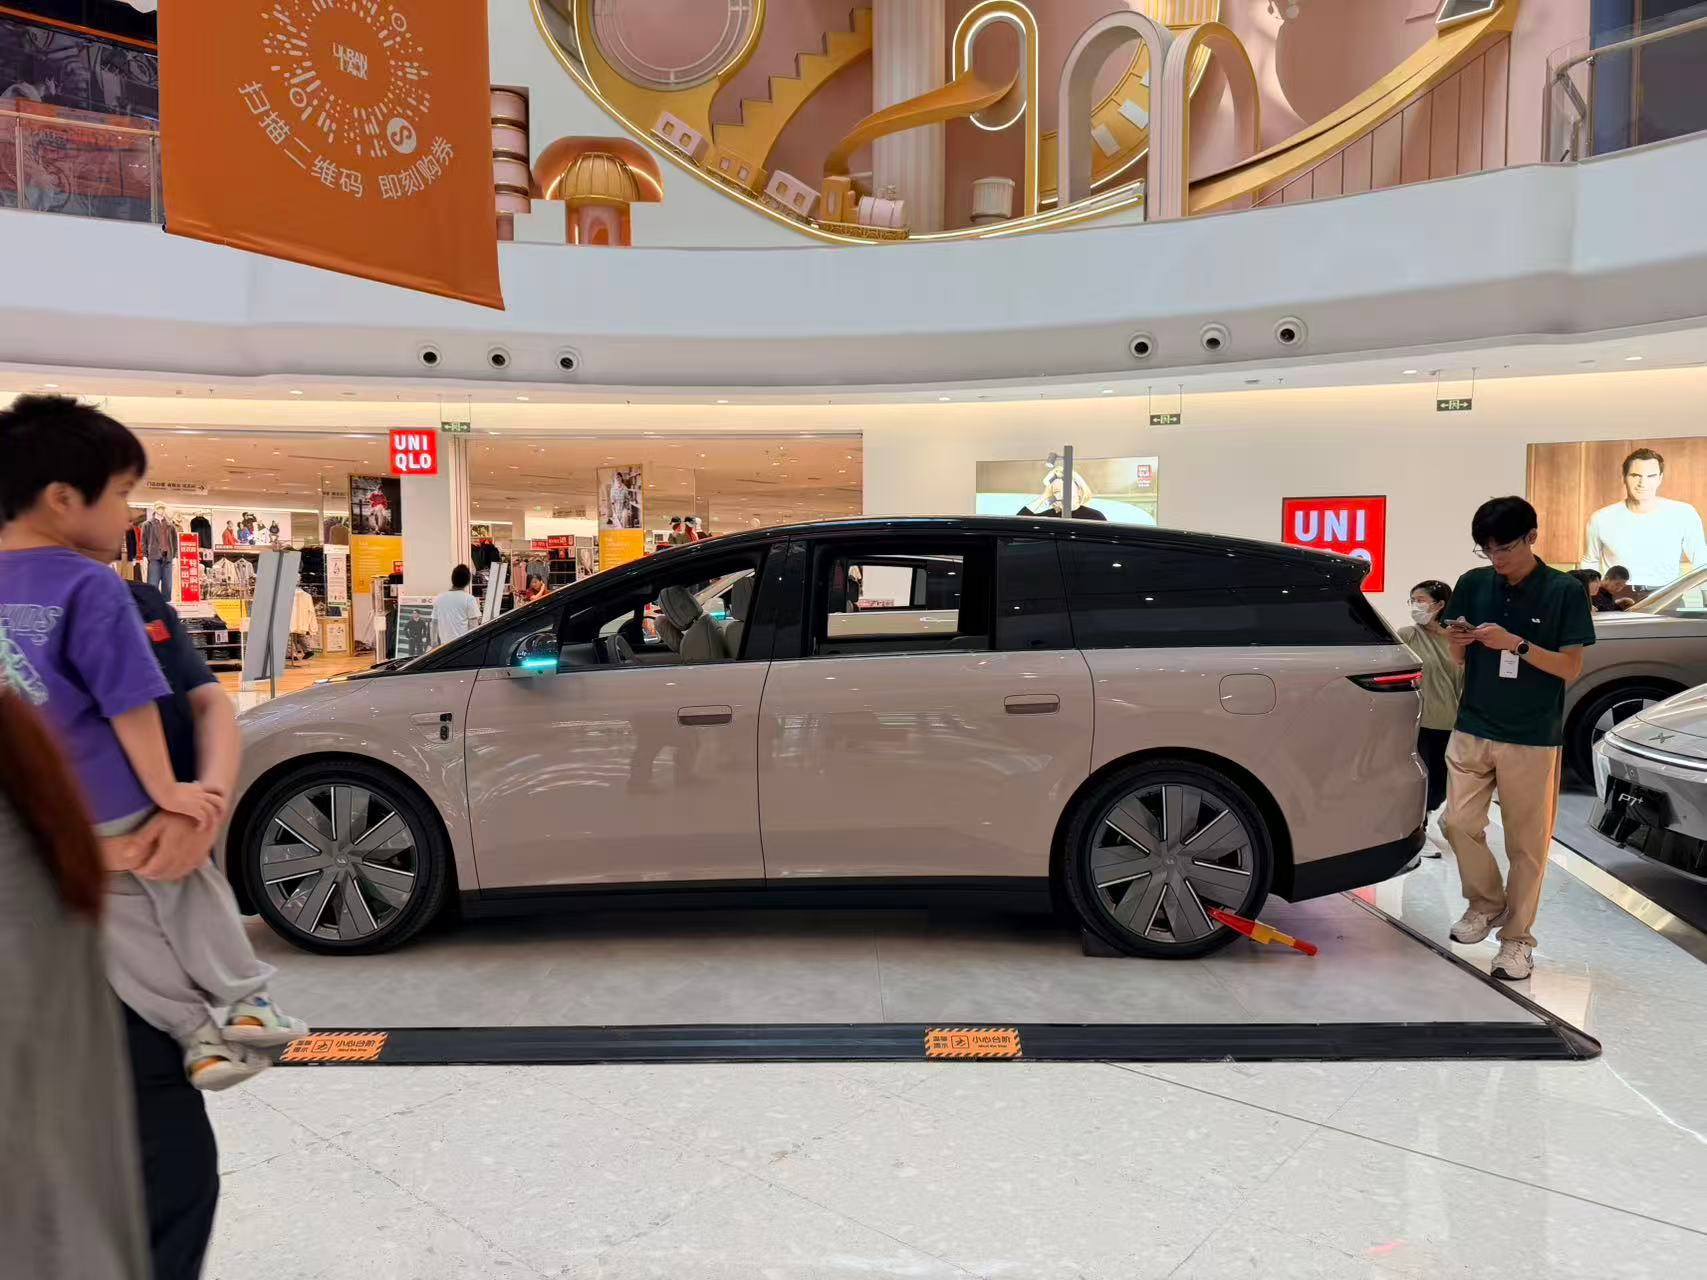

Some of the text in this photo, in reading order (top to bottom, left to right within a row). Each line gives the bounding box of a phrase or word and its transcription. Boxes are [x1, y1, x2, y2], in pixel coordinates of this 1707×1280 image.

[238, 80, 455, 199] 扫描二维码 即刻购券
[394, 434, 428, 451] UNI
[395, 453, 432, 472] QLO
[1294, 509, 1366, 542] UNI
[335, 1040, 375, 1048] 小心台阶
[972, 1035, 1011, 1043] 小心台阶
